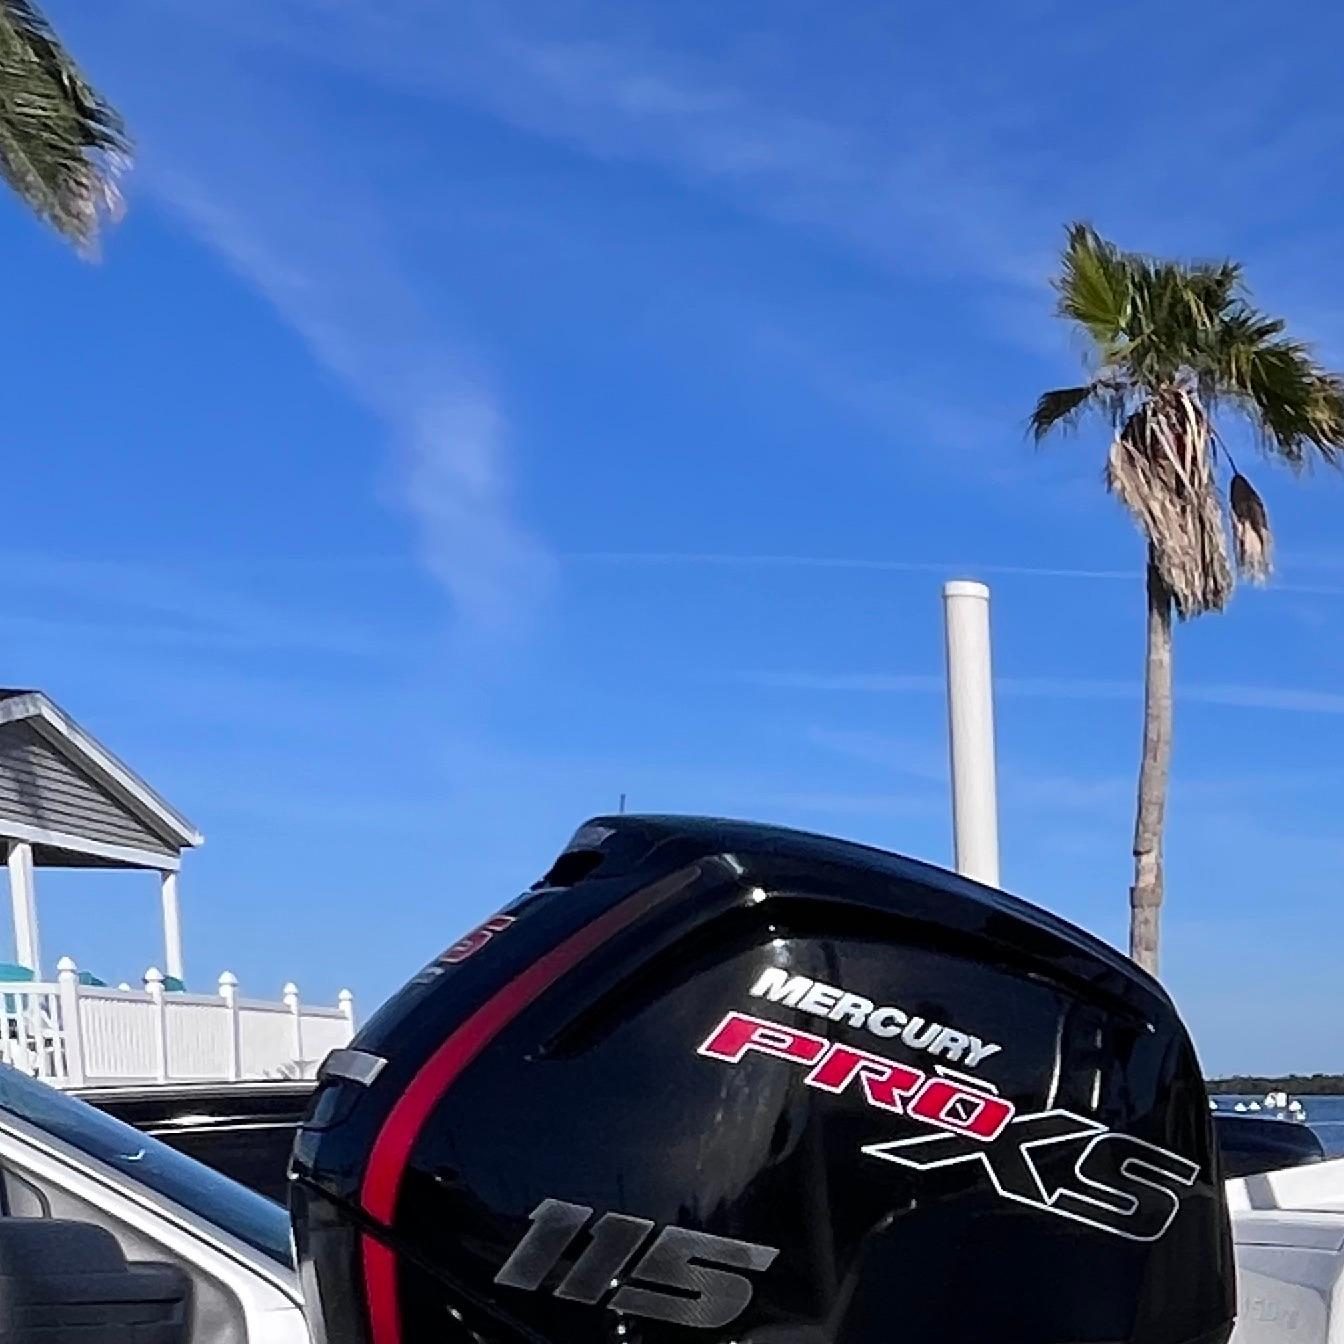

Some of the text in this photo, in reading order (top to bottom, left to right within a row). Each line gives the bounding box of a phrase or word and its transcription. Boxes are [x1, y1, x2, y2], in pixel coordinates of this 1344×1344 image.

[750, 967, 1000, 1068] MERCURY
[697, 1010, 1201, 1243] PRO XS
[494, 1199, 779, 1328] 115
